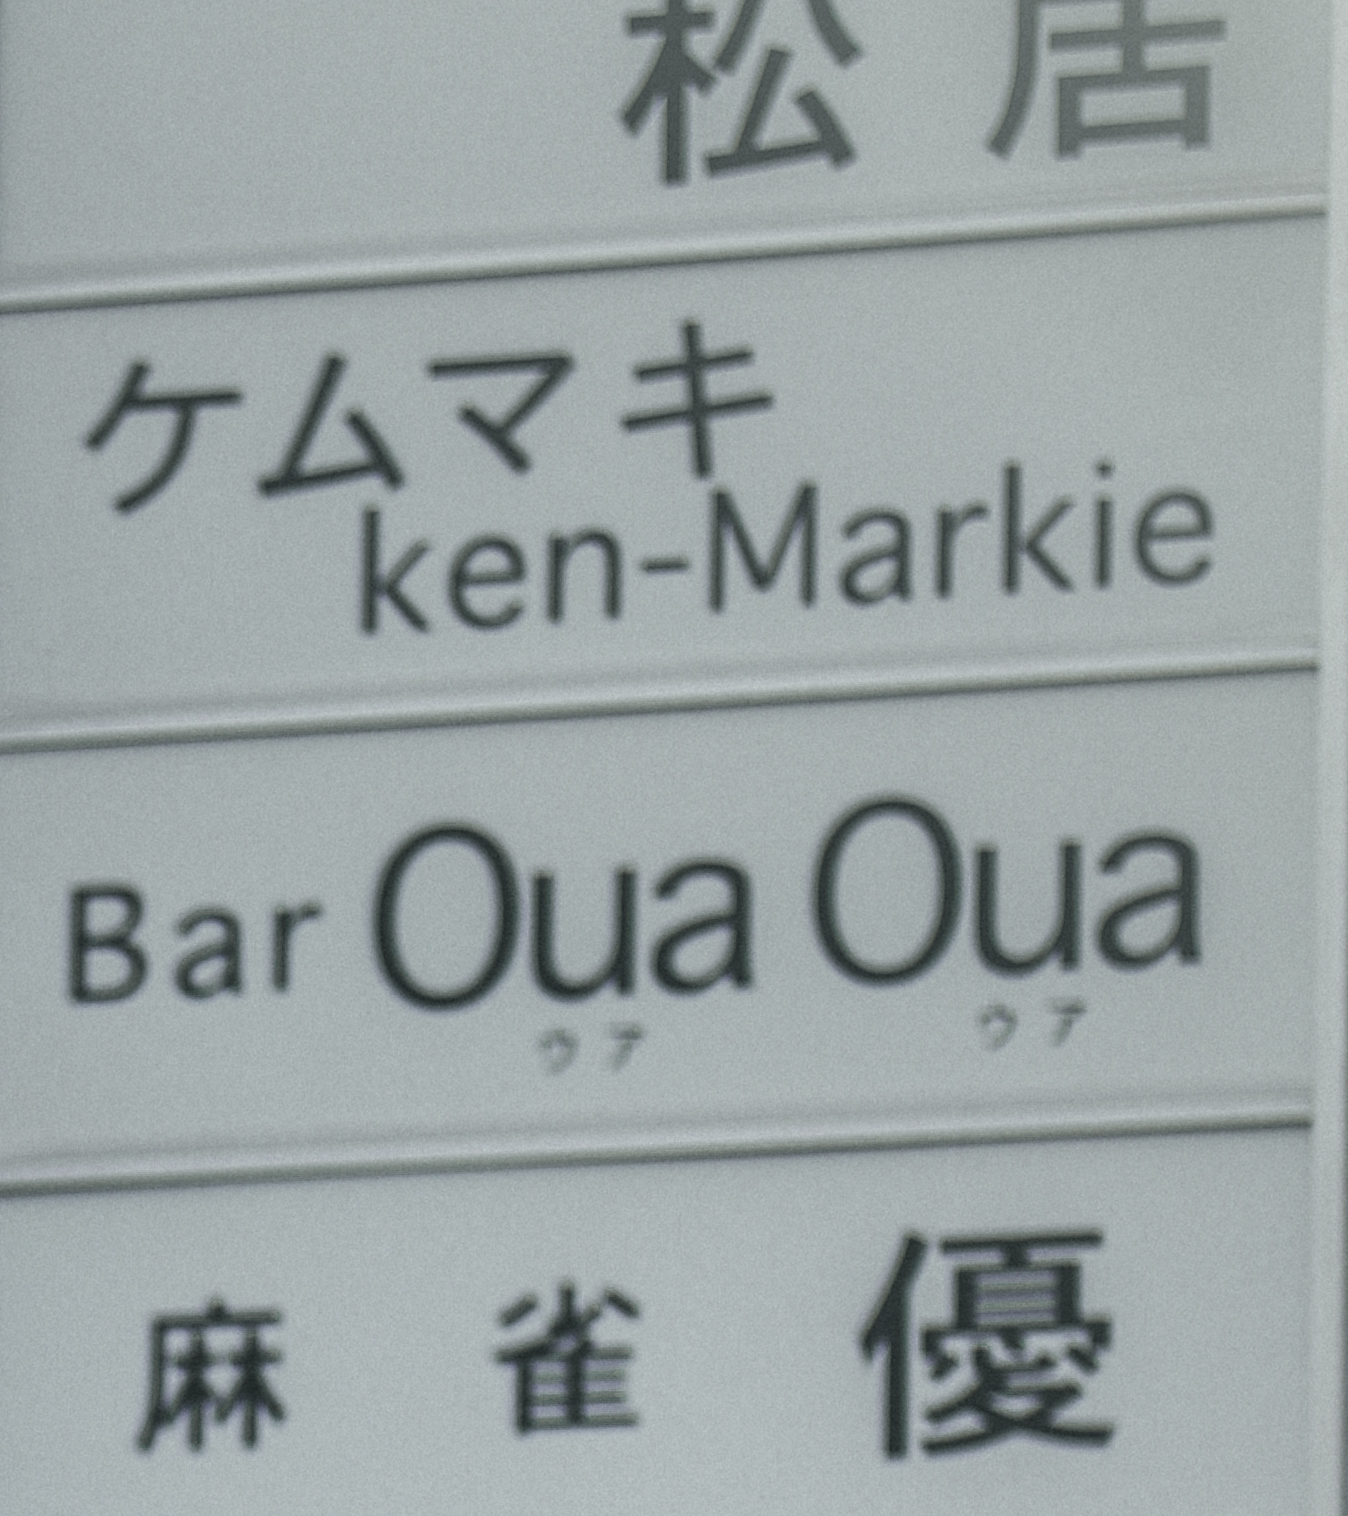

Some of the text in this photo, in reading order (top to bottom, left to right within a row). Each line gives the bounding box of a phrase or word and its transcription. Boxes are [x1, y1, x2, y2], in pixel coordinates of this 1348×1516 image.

[84, 320, 774, 515] ケムマキ
[359, 461, 1215, 637] ken-Markie
[67, 795, 1202, 1012] Bar Oua Oua
